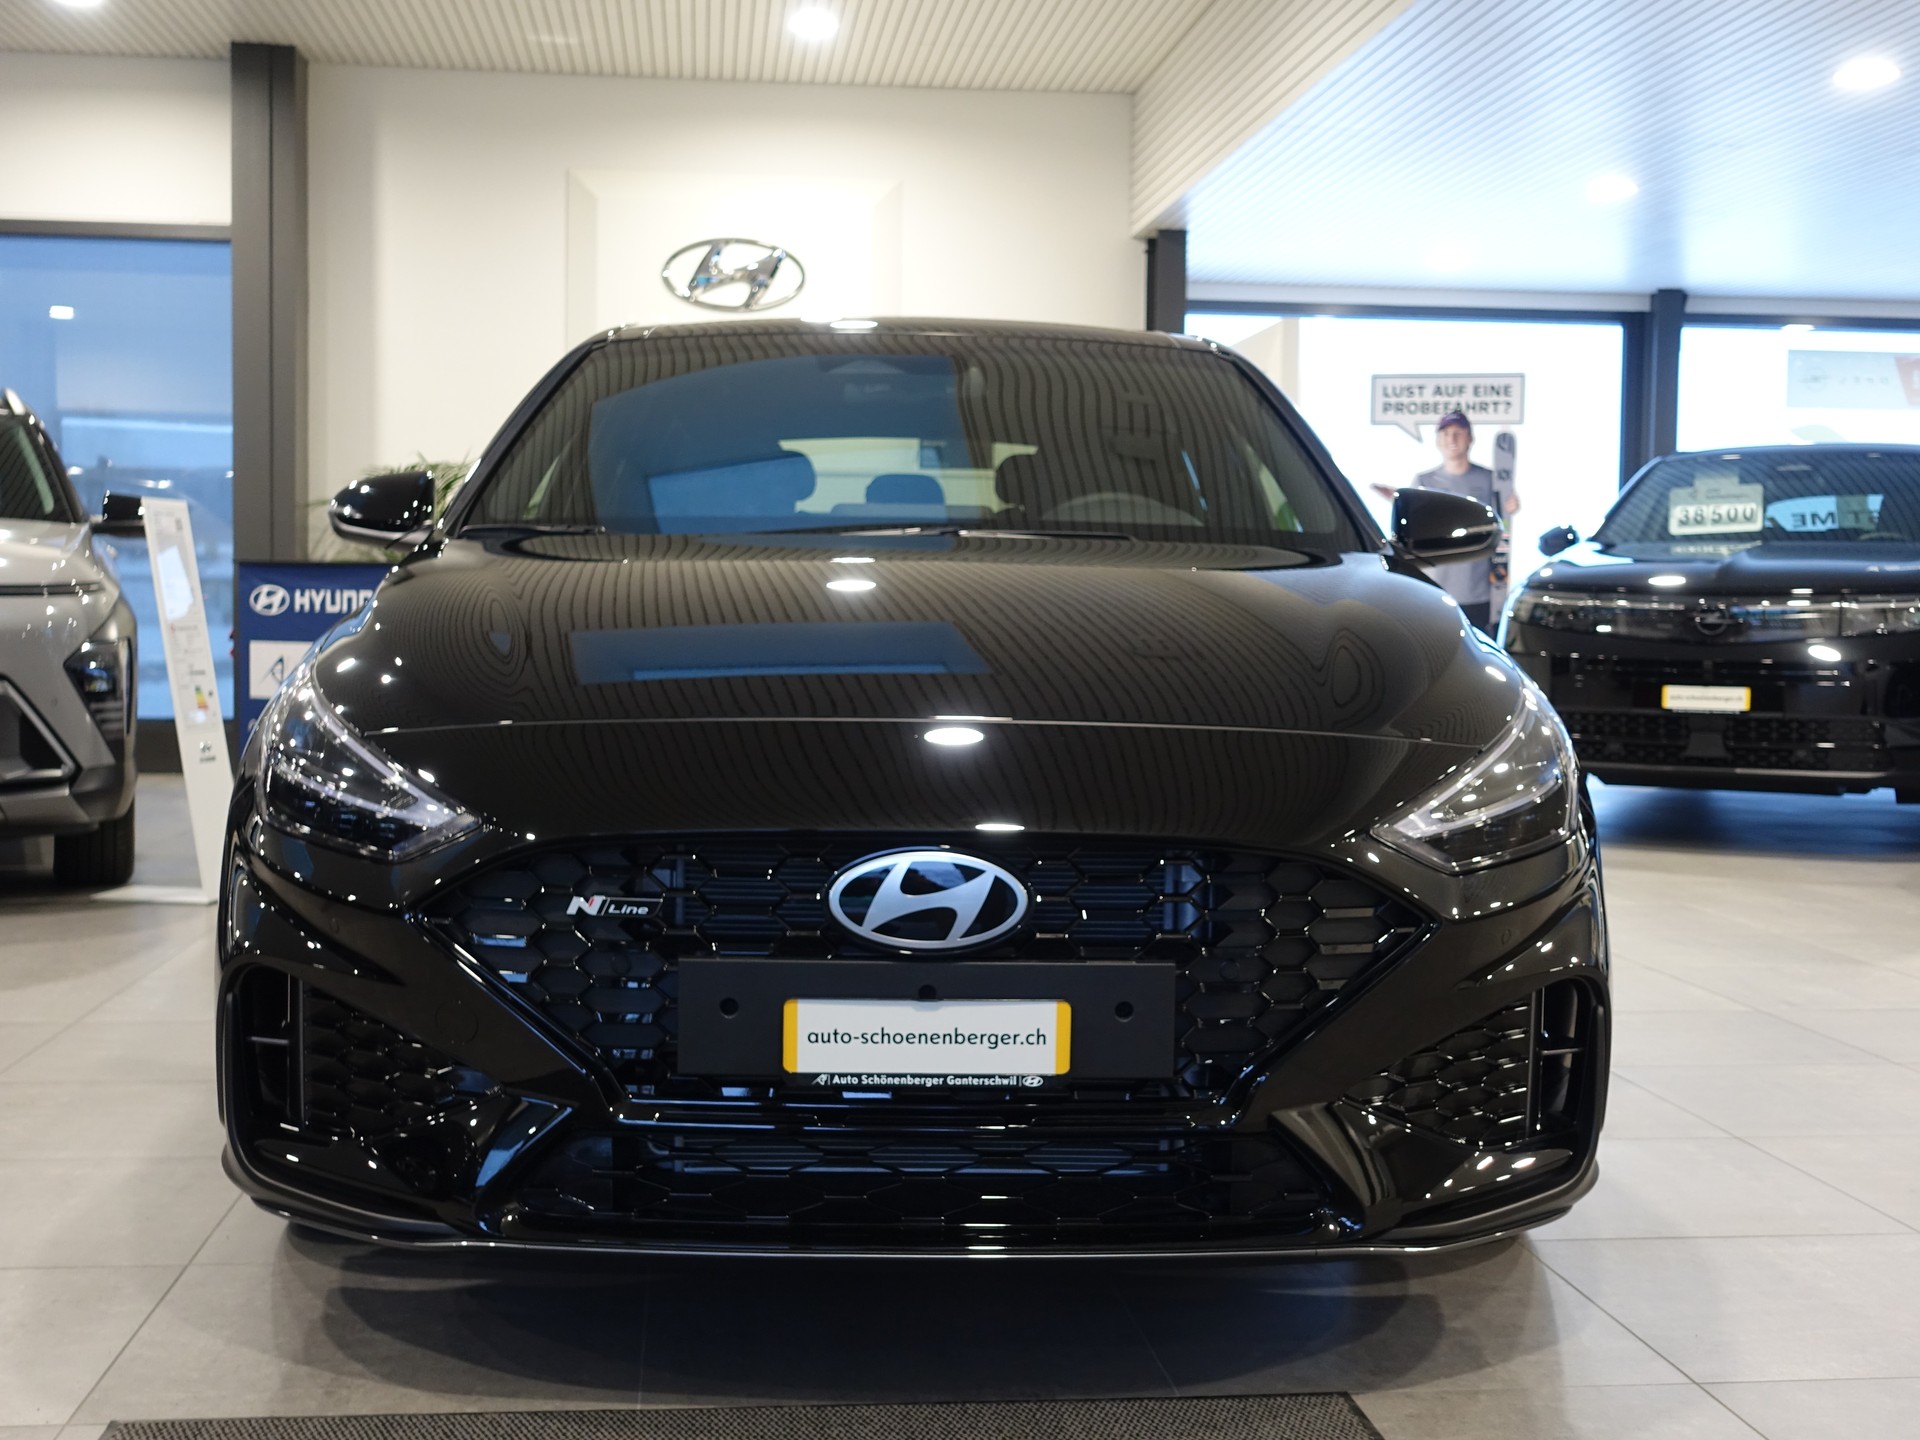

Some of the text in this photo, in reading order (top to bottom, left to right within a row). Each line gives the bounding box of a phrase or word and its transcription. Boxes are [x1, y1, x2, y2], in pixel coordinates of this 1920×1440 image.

[1382, 383, 1513, 398] LUST AUF EINE
[1382, 401, 1513, 415] PROBEFAHRT?
[566, 895, 649, 916] N Line
[807, 1026, 1047, 1050] auto-schoenenberger.ch
[832, 1074, 1017, 1087] Auto Schönenberger Ganterschwil
